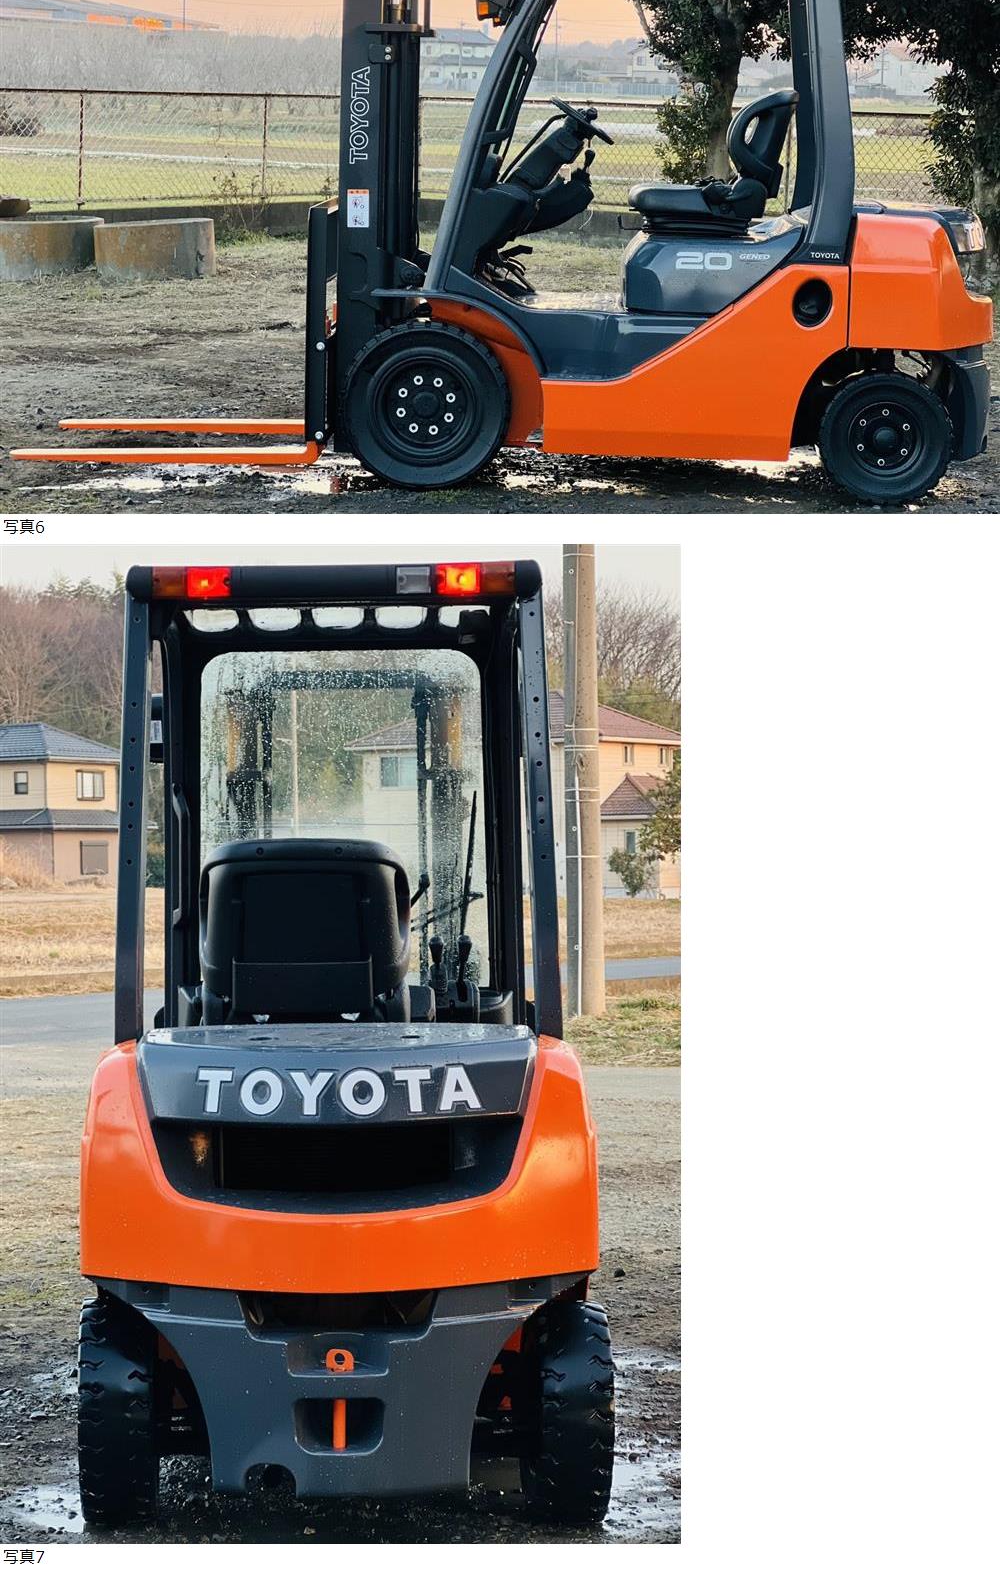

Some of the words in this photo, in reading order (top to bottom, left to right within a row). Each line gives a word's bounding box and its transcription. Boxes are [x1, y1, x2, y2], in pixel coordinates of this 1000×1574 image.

[349, 66, 370, 164] TOYOTA
[675, 252, 733, 270] 20
[738, 253, 771, 261] GENEO
[198, 1068, 482, 1116] TOYOTA
